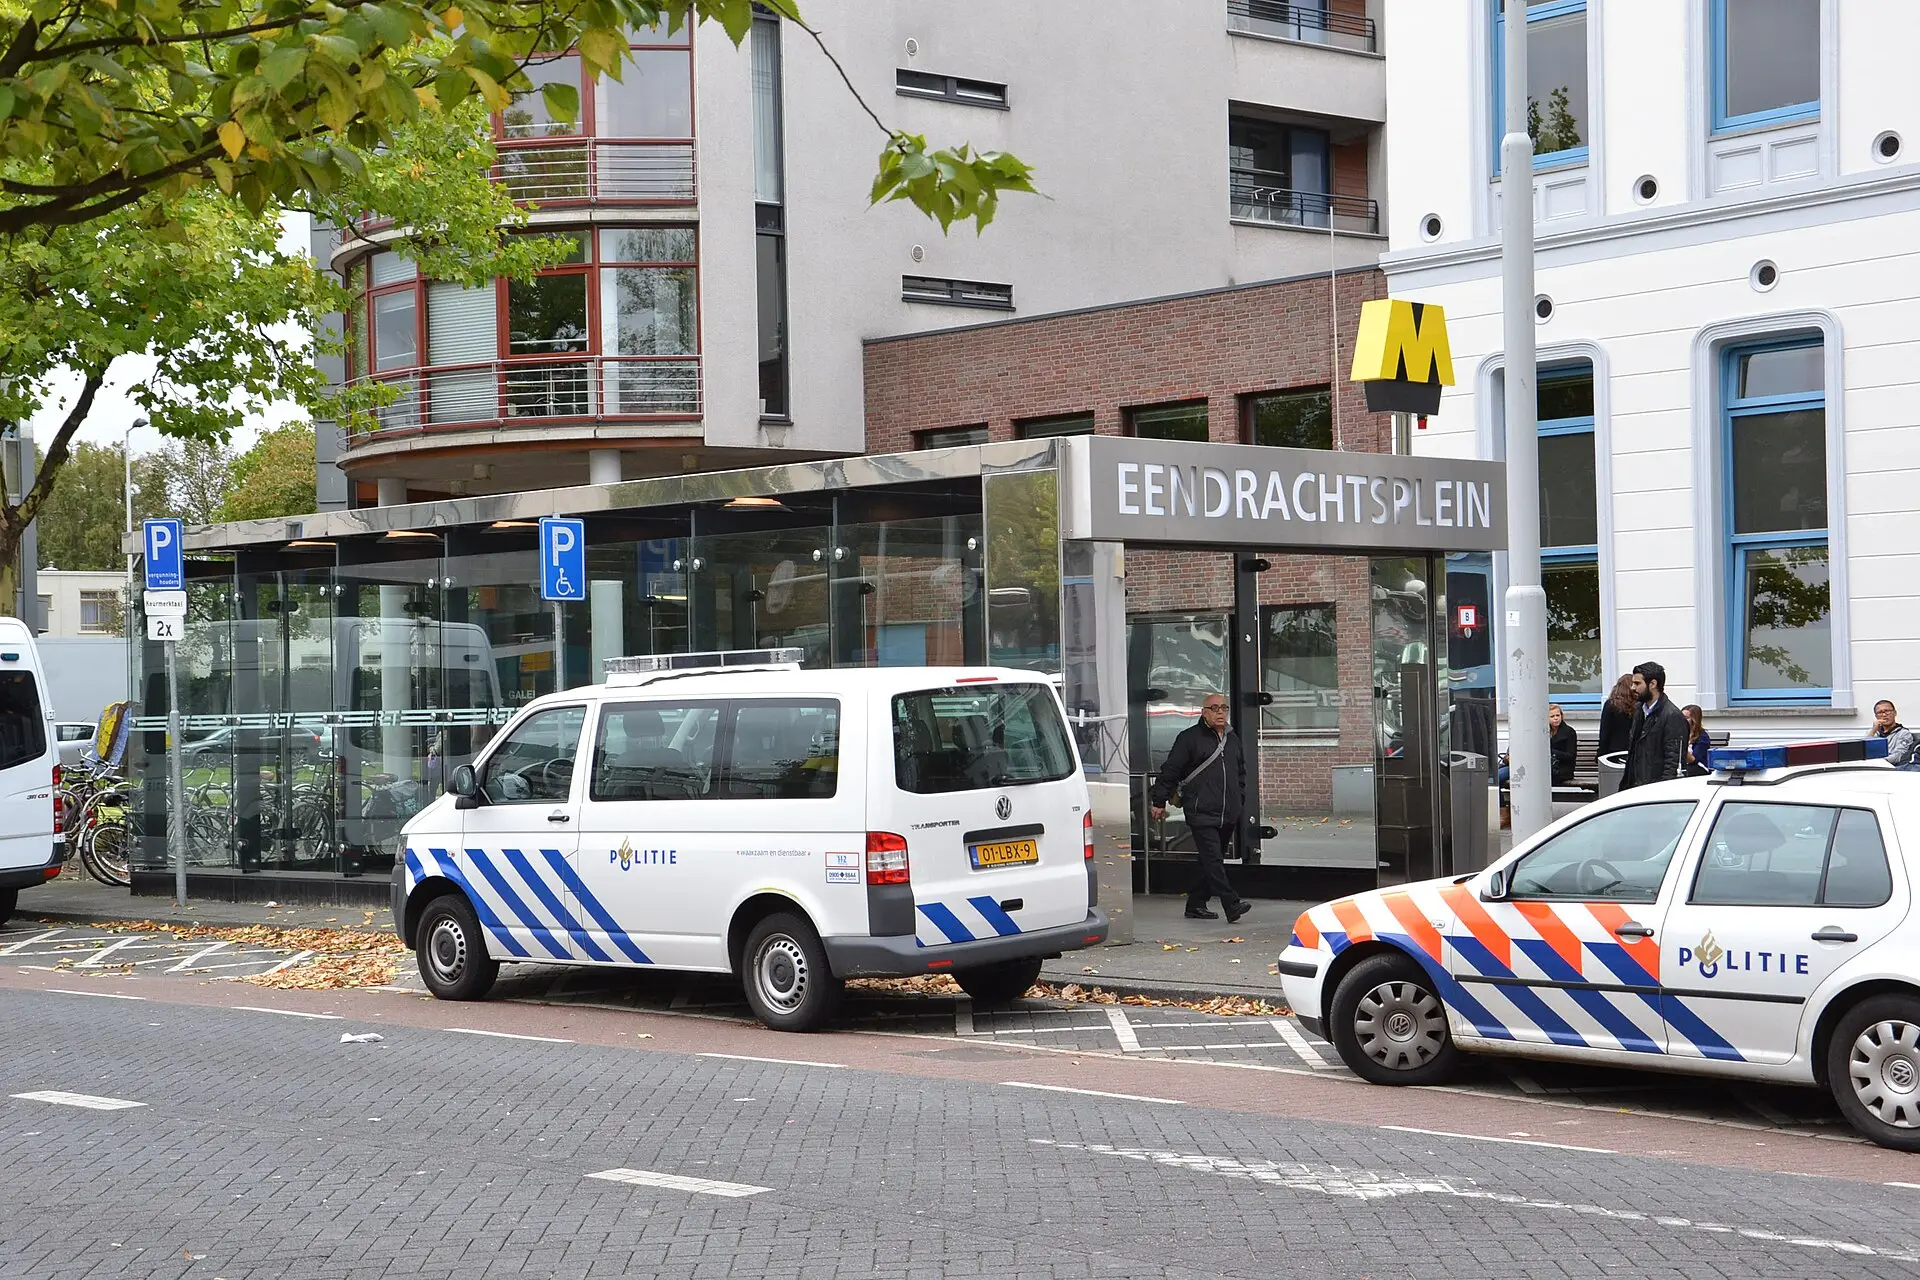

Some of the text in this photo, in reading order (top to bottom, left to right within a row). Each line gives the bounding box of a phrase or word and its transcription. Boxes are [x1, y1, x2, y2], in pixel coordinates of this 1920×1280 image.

[1380, 299, 1455, 386] M
[1117, 462, 1490, 528] EENDRACHTSPLEIN
[151, 525, 172, 560] P
[552, 526, 575, 566] P
[156, 620, 173, 637] 2x
[610, 849, 677, 872] POLITIE
[982, 843, 1031, 862] 01-LBX-9
[1679, 947, 1809, 979] POLITIE
